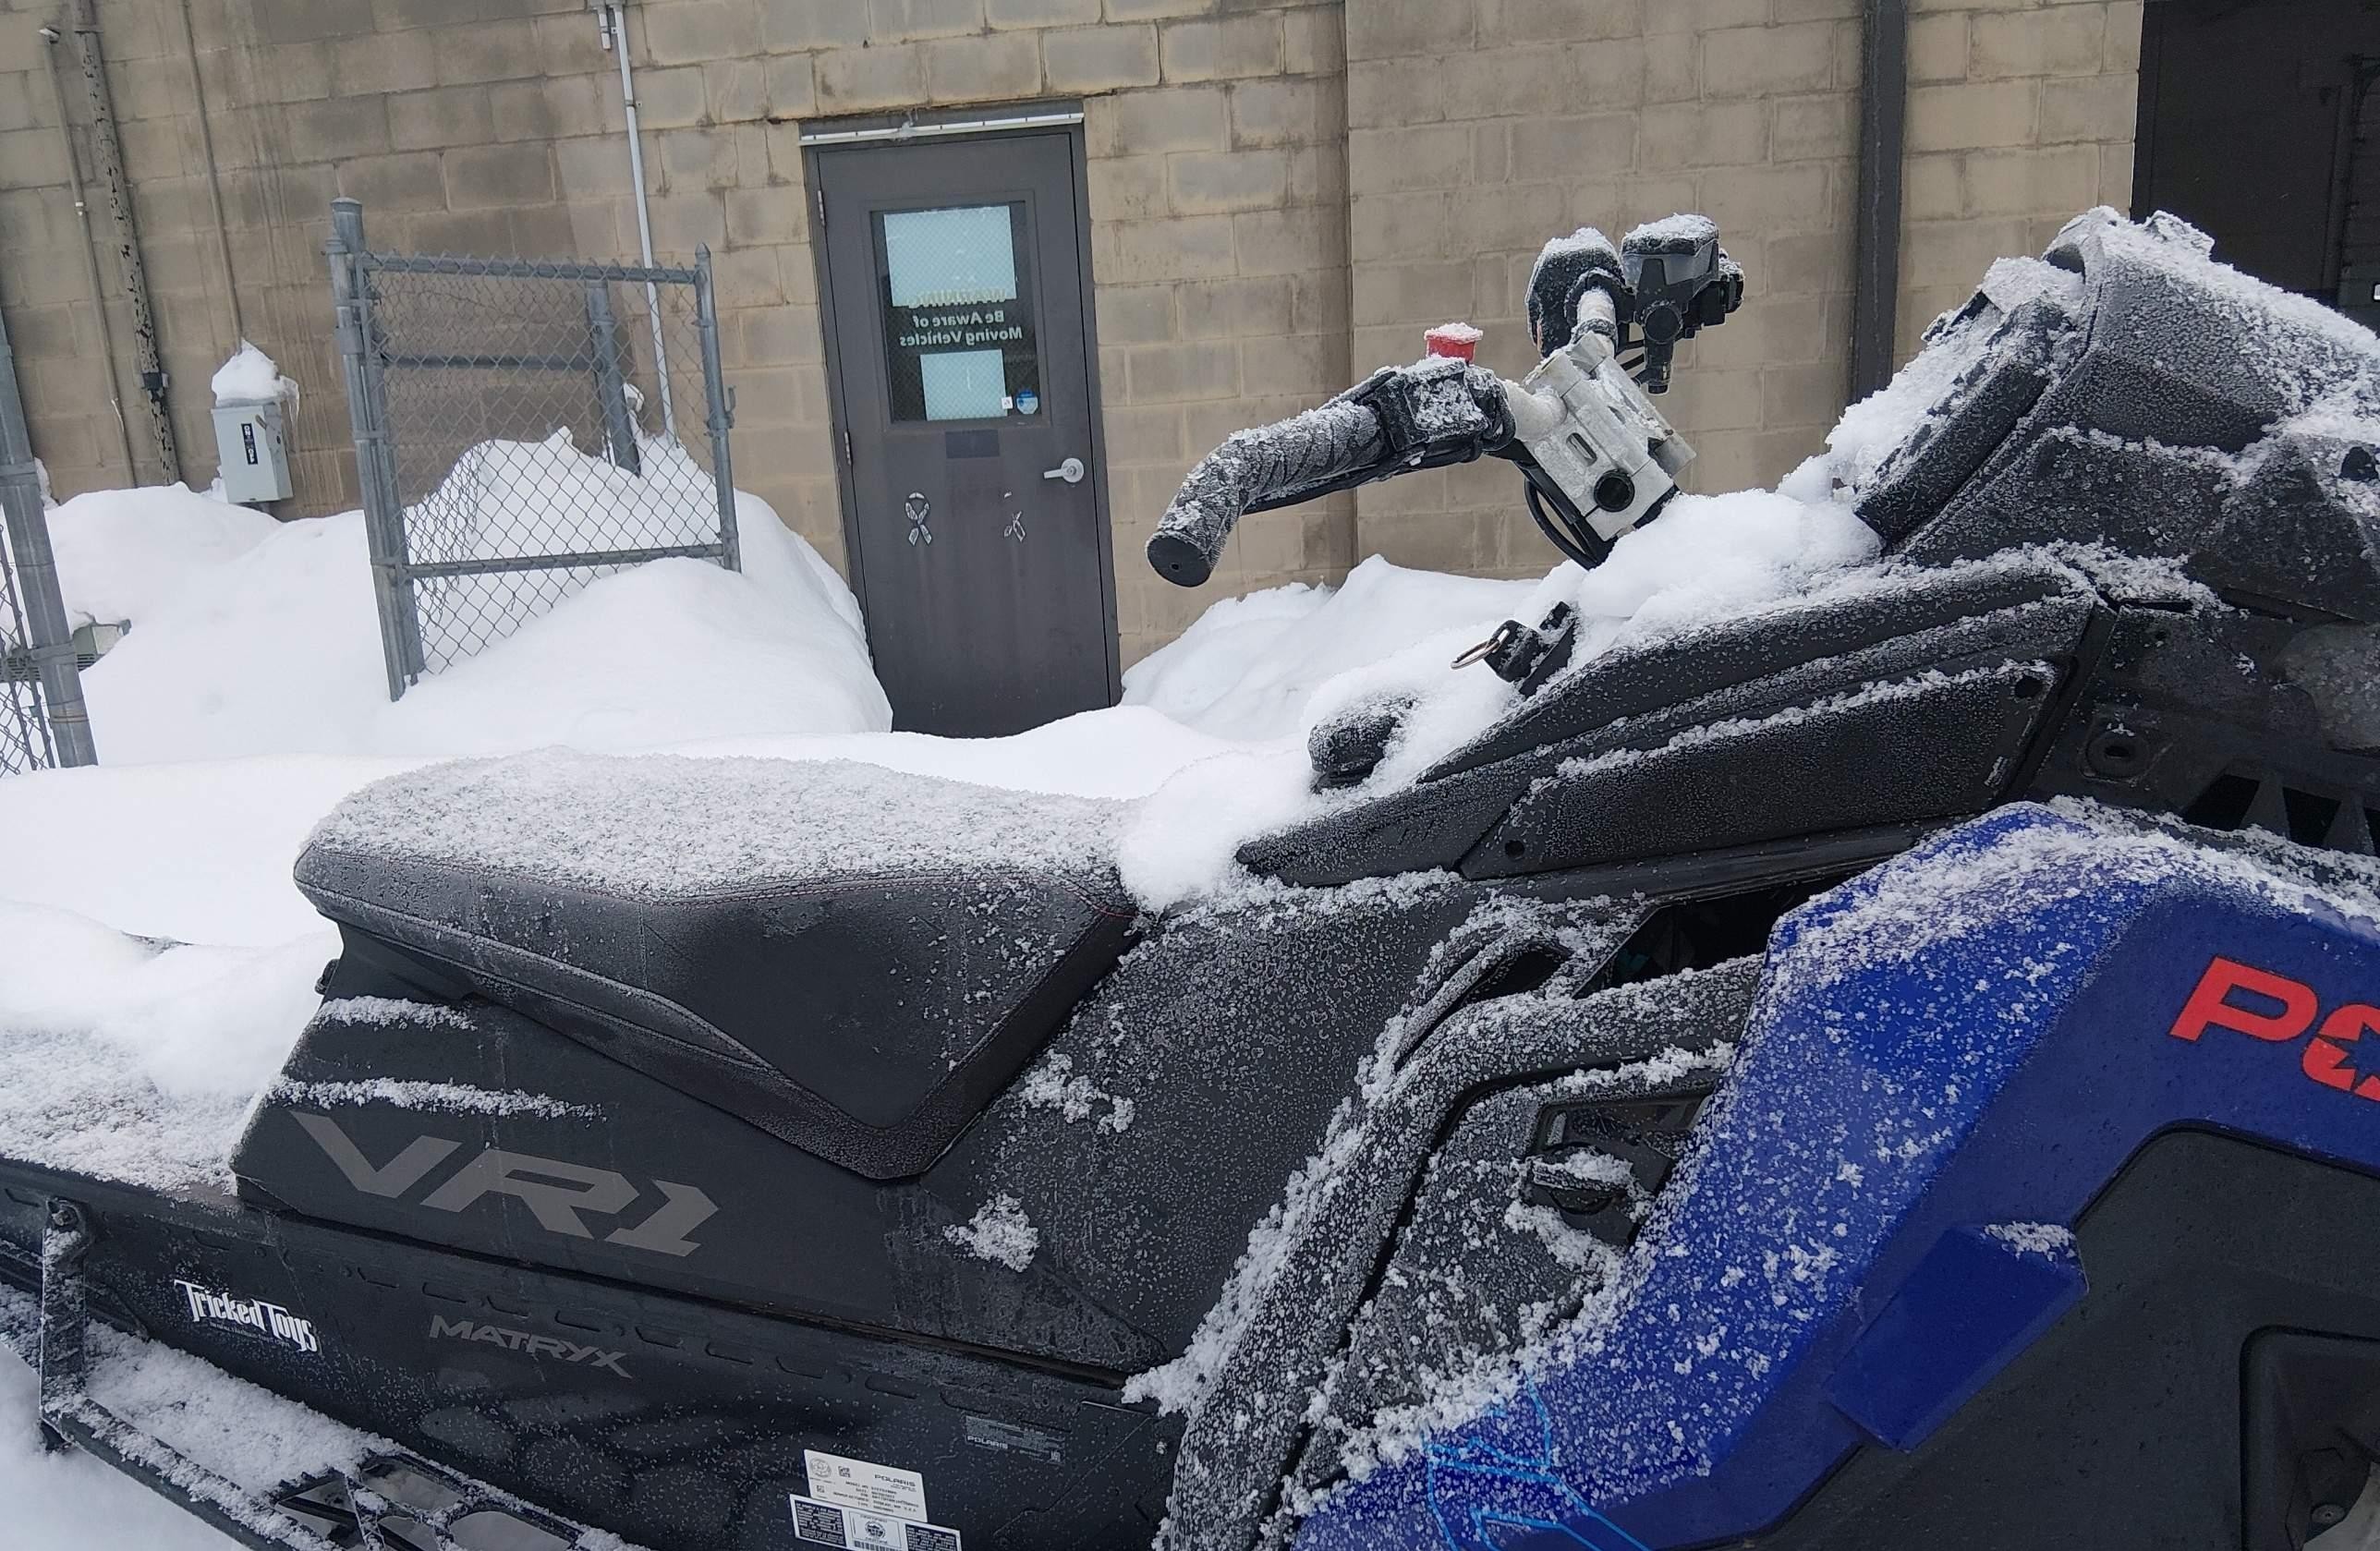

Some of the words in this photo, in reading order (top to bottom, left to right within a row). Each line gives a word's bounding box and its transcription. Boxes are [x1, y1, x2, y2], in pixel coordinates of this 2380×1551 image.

[288, 1110, 720, 1257] VR1
[174, 1278, 268, 1332] Tricked
[256, 1300, 318, 1352] Toys
[429, 1314, 633, 1379] MATRYX
[966, 1436, 1009, 1449] POLARIS
[874, 1474, 916, 1486] POLARIS
